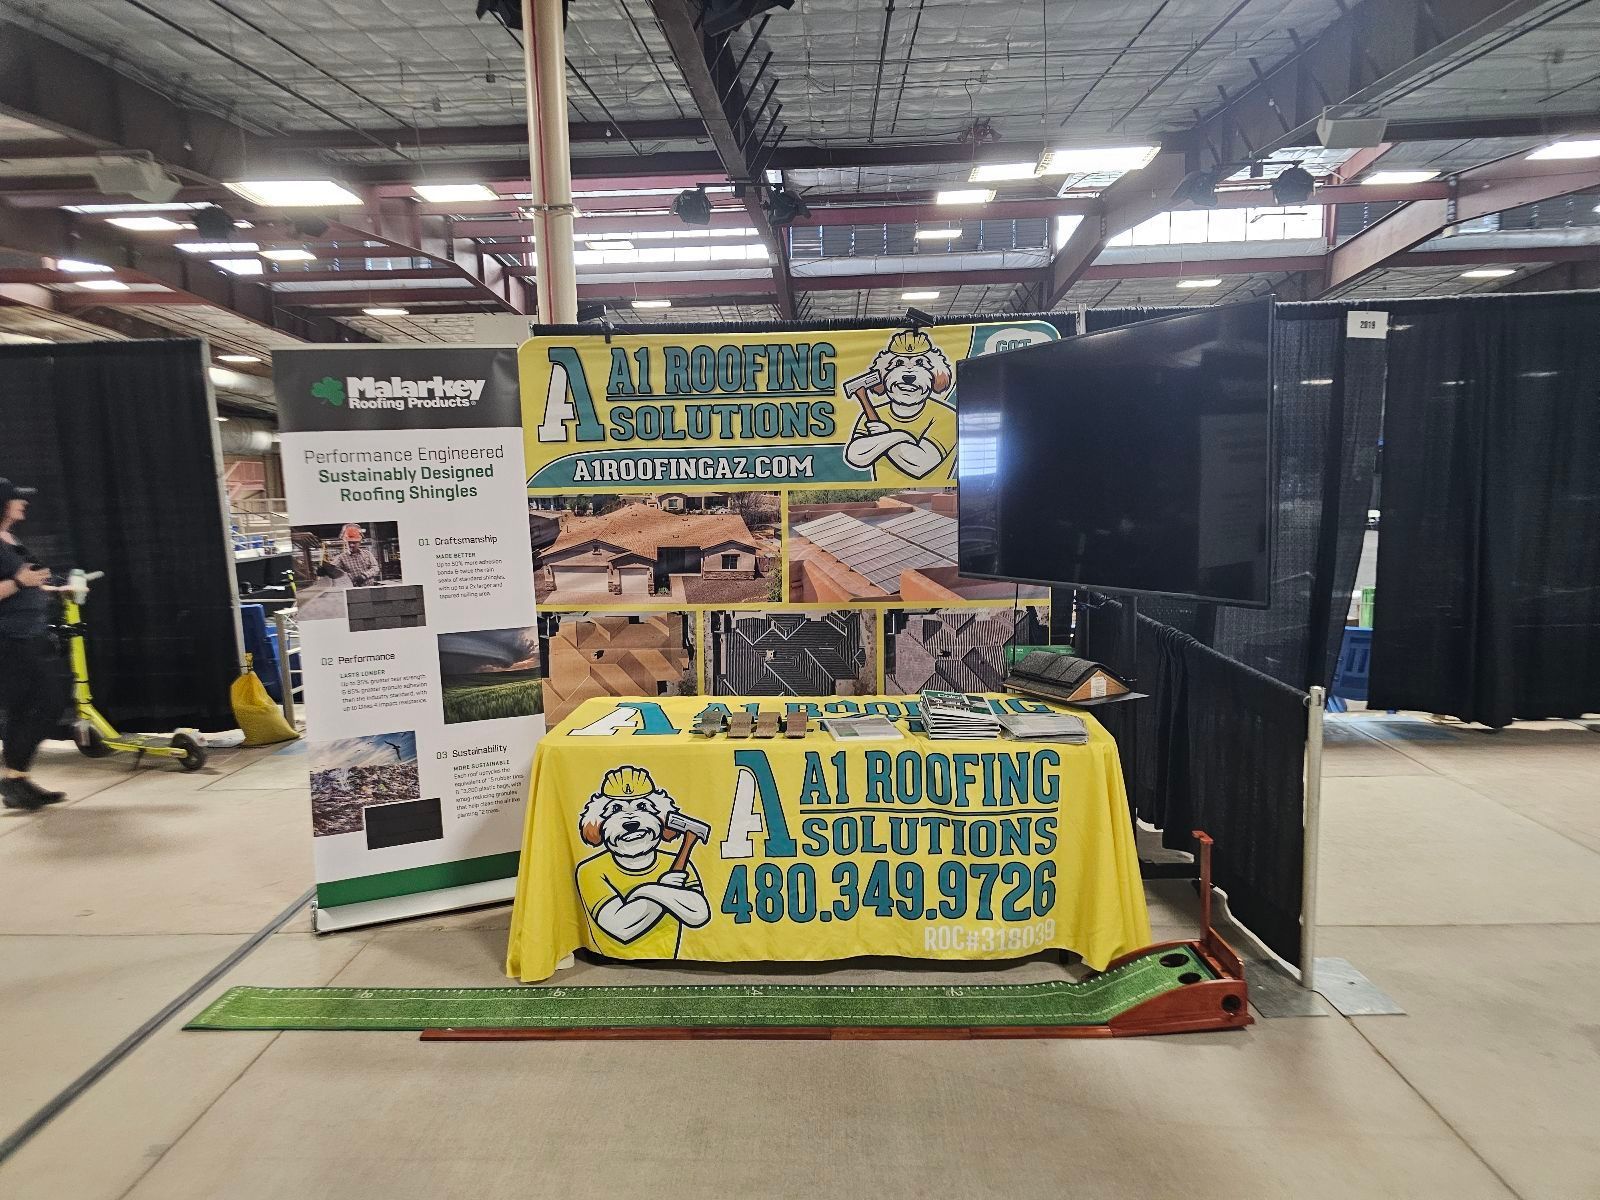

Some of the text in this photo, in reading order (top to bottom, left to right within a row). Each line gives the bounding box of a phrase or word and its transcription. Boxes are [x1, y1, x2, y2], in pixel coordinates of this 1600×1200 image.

[606, 343, 837, 395] A1 ROOFING
[346, 375, 486, 401] Malarkey
[537, 347, 607, 443] A
[349, 397, 405, 411] Roofing
[609, 401, 836, 442] SOLUTIONS
[304, 445, 504, 464] Performance Engineered
[573, 454, 814, 482] A1ROOFINGAZ.COM
[319, 464, 494, 485] Sustainably Designed
[341, 484, 478, 503] Roofing Shingles
[418, 534, 498, 546] 01 Craftsmanship
[321, 653, 395, 666] 02 Performance
[567, 702, 682, 735] A
[436, 744, 508, 759] 03 Sustainability
[471, 760, 510, 769] SUSTAINABLE
[799, 749, 1060, 807] A1 ROOFING
[720, 750, 797, 859] A
[802, 816, 1058, 858] SOLUTIONS
[720, 859, 1056, 924] 480.349.9726
